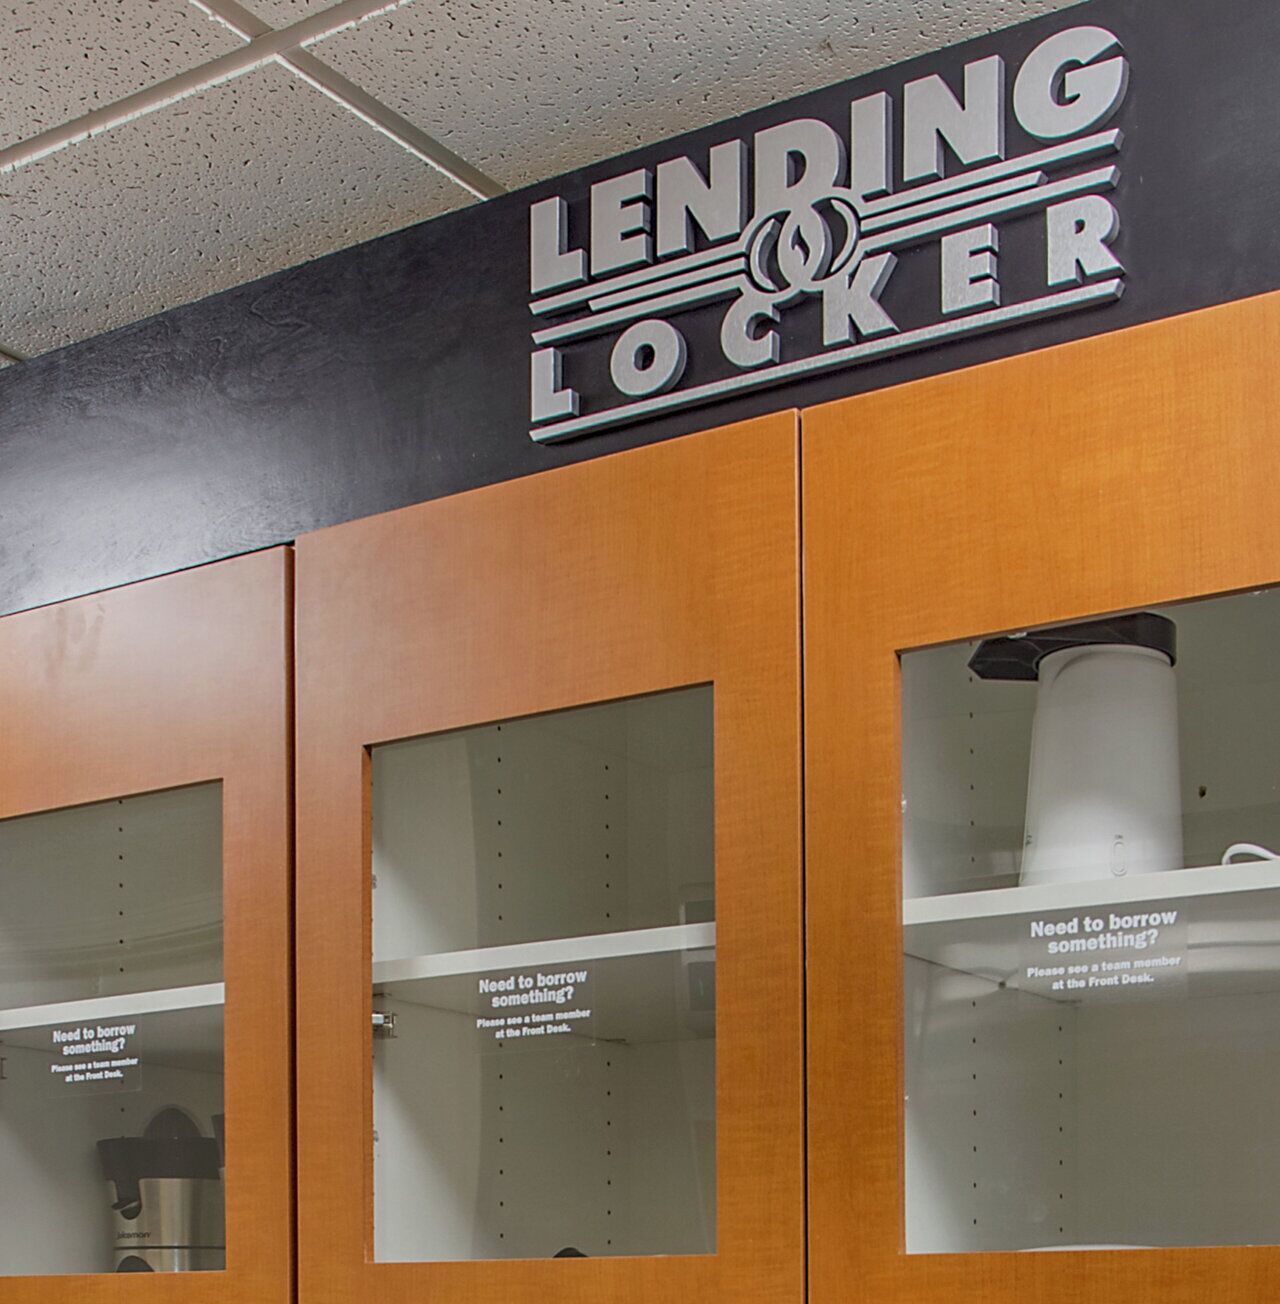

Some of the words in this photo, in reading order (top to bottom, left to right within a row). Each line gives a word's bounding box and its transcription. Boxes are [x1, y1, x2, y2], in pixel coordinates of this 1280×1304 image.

[529, 25, 1128, 295] LENDING
[529, 194, 1126, 424] LOCKER
[1030, 917, 1078, 937] Need
[1083, 917, 1104, 932] to
[1109, 911, 1177, 930] borrow
[1048, 929, 1158, 953] something?
[1027, 967, 1065, 978] Please
[1068, 965, 1088, 974] see
[1091, 963, 1099, 972] a
[1101, 961, 1131, 971] team
[1133, 955, 1181, 968] member
[479, 976, 515, 993] Need
[518, 975, 533, 989] to
[537, 970, 587, 987] borrow
[1052, 980, 1064, 990] at
[1067, 977, 1086, 988] the
[1089, 975, 1119, 987] Front
[1122, 973, 1154, 984] Desk.
[492, 986, 574, 1008] something?
[477, 1018, 505, 1028] Please
[507, 1016, 522, 1025] see
[524, 1015, 531, 1023] a
[532, 1013, 554, 1022] team
[555, 1008, 591, 1020] member
[53, 1028, 80, 1043] Need
[83, 1027, 95, 1039] to
[97, 1025, 135, 1038] borrow
[495, 1030, 505, 1039] at
[506, 1027, 520, 1037] the
[522, 1026, 545, 1036] Front
[546, 1023, 571, 1033] Desk.
[63, 1037, 125, 1055] something?
[51, 1064, 73, 1073] Please
[74, 1063, 86, 1071] see
[93, 1060, 110, 1068] team
[111, 1057, 138, 1067] member
[65, 1074, 73, 1082] at
[74, 1073, 84, 1081] the
[86, 1071, 103, 1080] Front
[104, 1070, 123, 1078] Desk.
